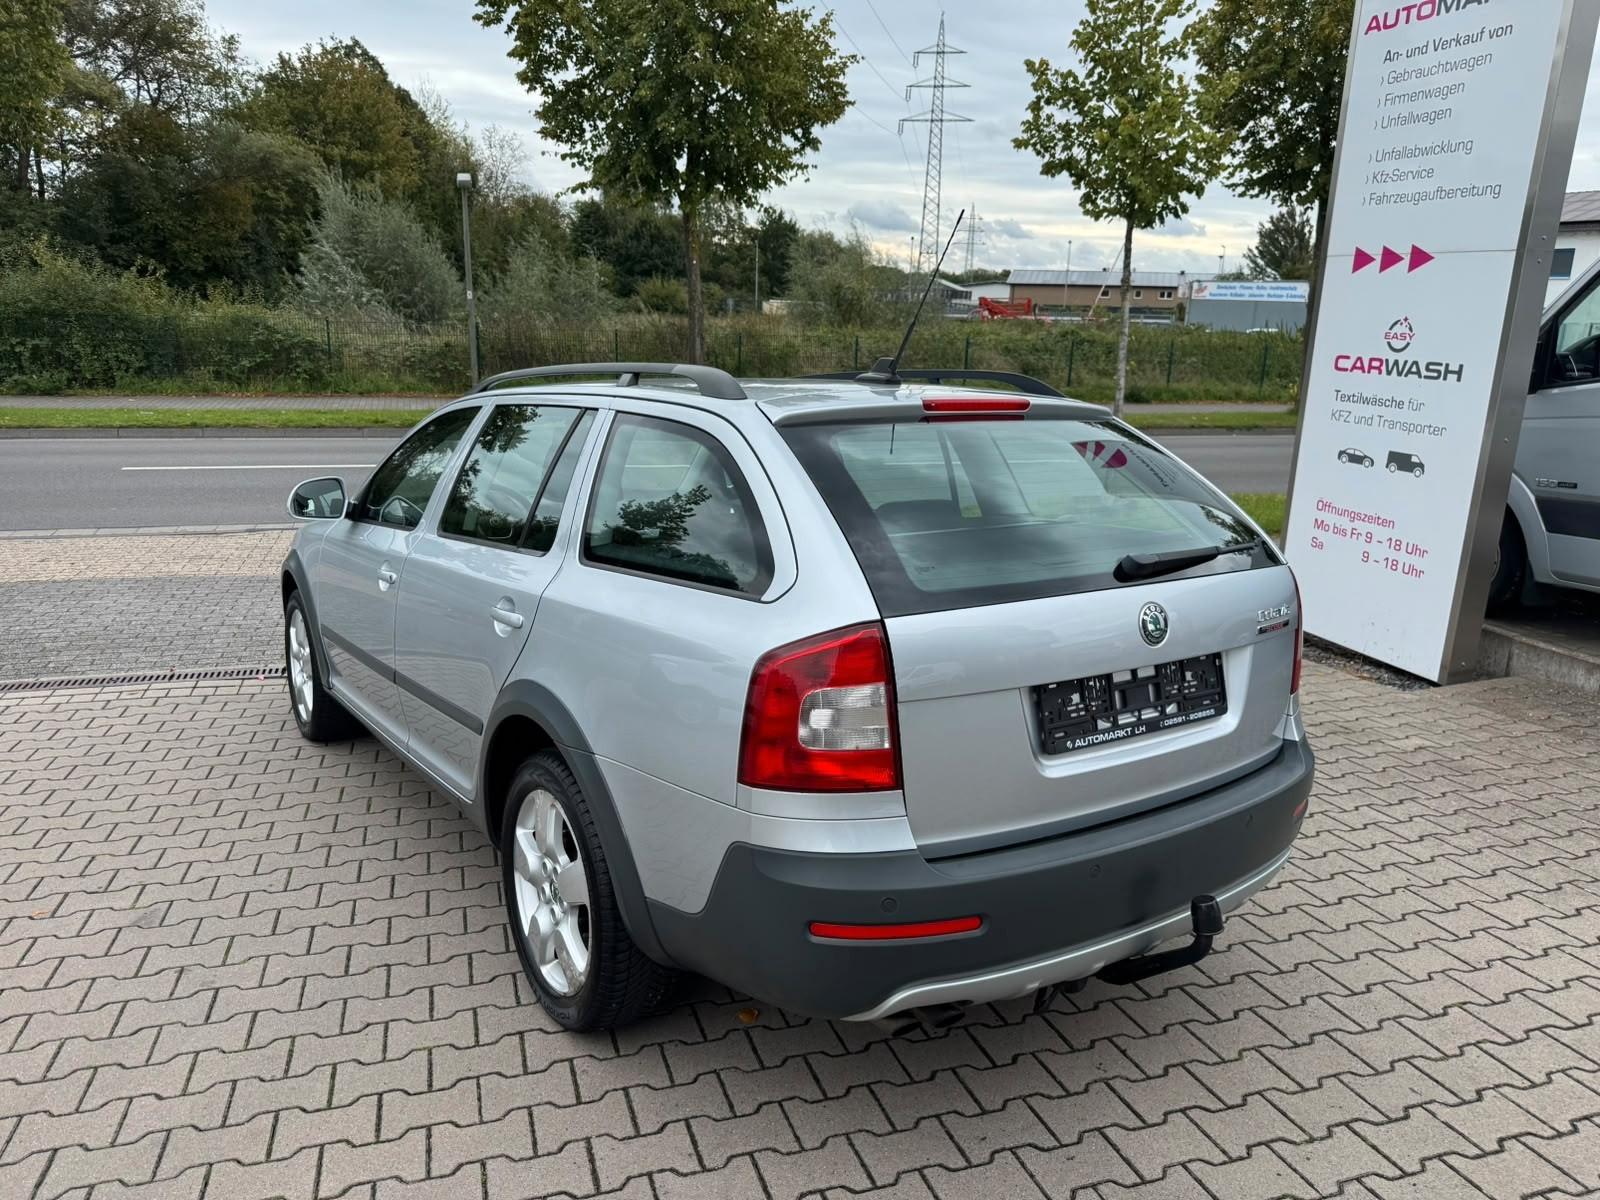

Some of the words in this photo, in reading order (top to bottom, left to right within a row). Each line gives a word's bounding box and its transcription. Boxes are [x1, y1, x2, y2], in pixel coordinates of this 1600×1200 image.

[1383, 49, 1403, 64] An-
[1406, 41, 1428, 58] und
[1432, 28, 1485, 52] Verkauf
[1489, 23, 1513, 40] von
[1387, 52, 1493, 85] Gebrauchtwagen
[1384, 81, 1465, 107] Firmenwagen
[1381, 107, 1452, 129] Unfallwagen
[1375, 138, 1473, 163] Unfallabwicklung
[1372, 166, 1434, 184] Kfz-Service
[1369, 183, 1501, 207] Fahrzeugaufbereitung
[1384, 331, 1415, 341] EASY
[1333, 354, 1463, 383] CARWASH
[1334, 390, 1404, 410] Textilwäsche
[1407, 398, 1425, 412] für
[1331, 410, 1350, 423] KFZ
[1354, 414, 1373, 427] und
[1377, 416, 1447, 437] Transporter
[1314, 518, 1330, 532] Mo
[1332, 525, 1347, 538] bis
[1350, 529, 1362, 541] Fr
[1364, 531, 1373, 544] 9
[1386, 537, 1401, 551] 18
[1405, 542, 1428, 558] Uhr
[1311, 537, 1324, 550] Sa
[1361, 551, 1370, 562] 9
[1383, 557, 1398, 571] 18
[1402, 561, 1424, 578] Uhr
[1075, 728, 1132, 748] AUTOMARKT
[1135, 725, 1146, 733] LH
